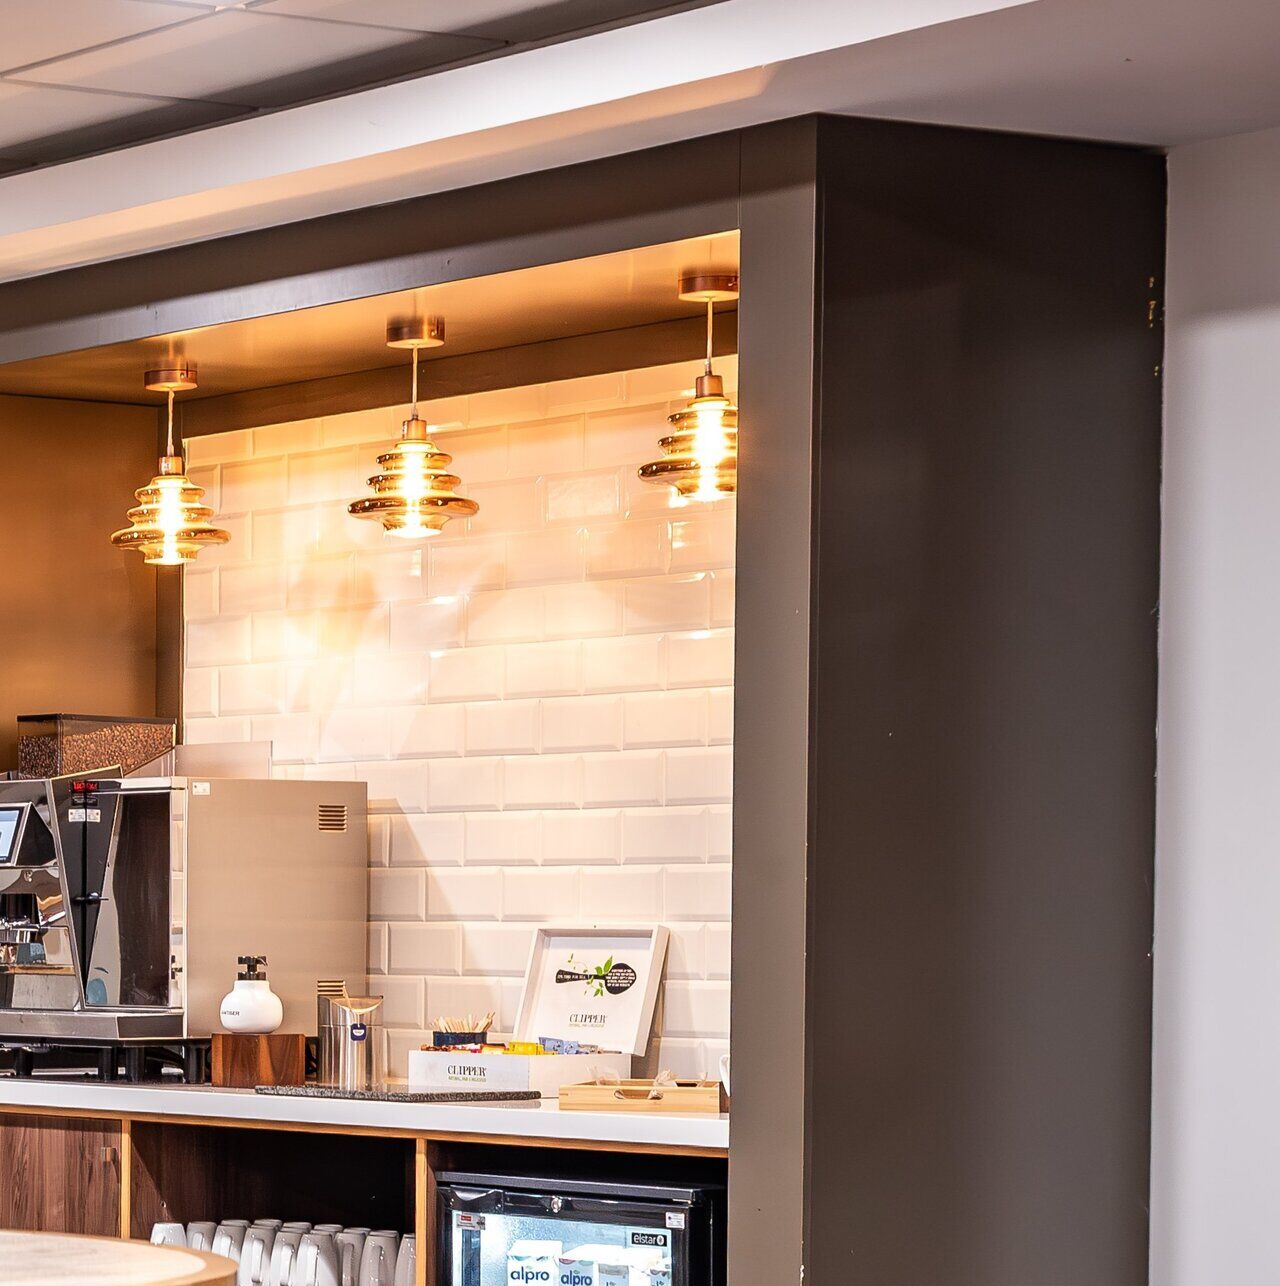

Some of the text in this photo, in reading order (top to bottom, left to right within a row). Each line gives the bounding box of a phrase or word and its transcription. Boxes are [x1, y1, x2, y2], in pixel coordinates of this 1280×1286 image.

[569, 1014, 606, 1024] CLIPPER
[448, 1065, 486, 1077] CLIPPER
[510, 1266, 550, 1284] alpro
